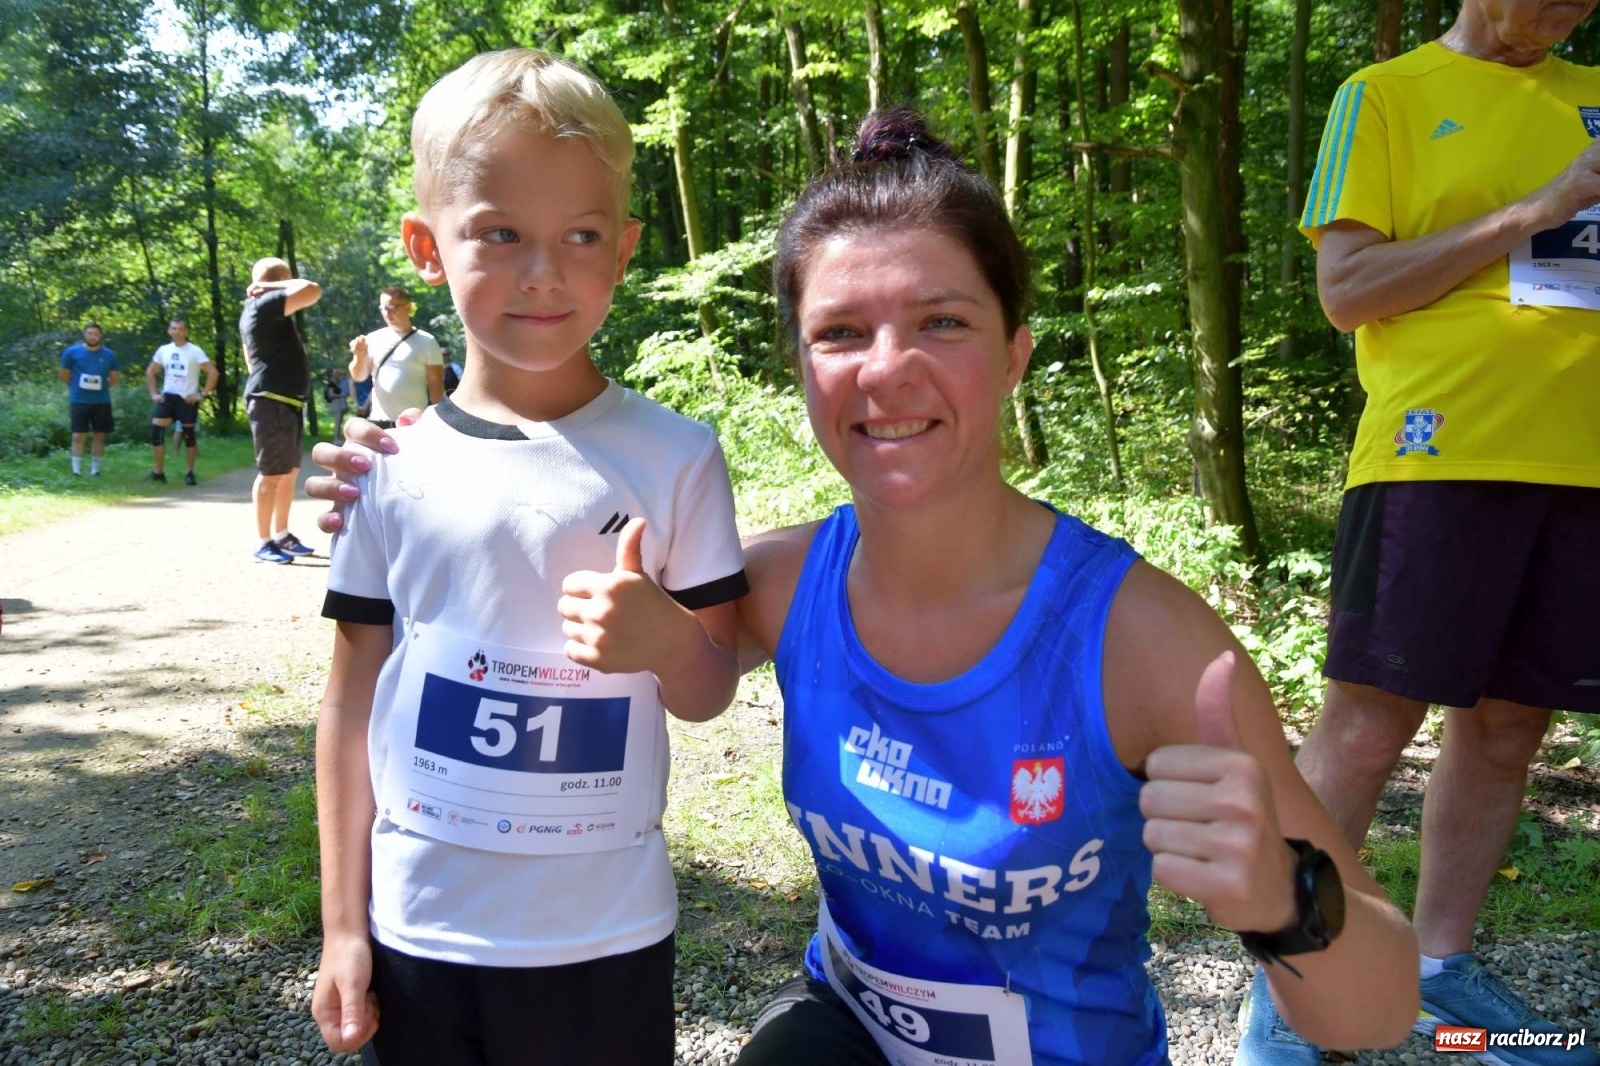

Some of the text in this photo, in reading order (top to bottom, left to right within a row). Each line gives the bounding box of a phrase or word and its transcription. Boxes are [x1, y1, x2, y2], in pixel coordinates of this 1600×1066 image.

[1572, 224, 1600, 254] 4
[492, 660, 590, 681] TROPEMWILCZYM
[470, 697, 563, 762] 51
[1014, 741, 1064, 753] POLAND
[413, 756, 448, 775] 1963 m
[560, 777, 622, 791] godz. 11.00
[529, 825, 563, 834] PGNiG
[944, 909, 1030, 940] TEAM
[859, 990, 931, 1043] 49
